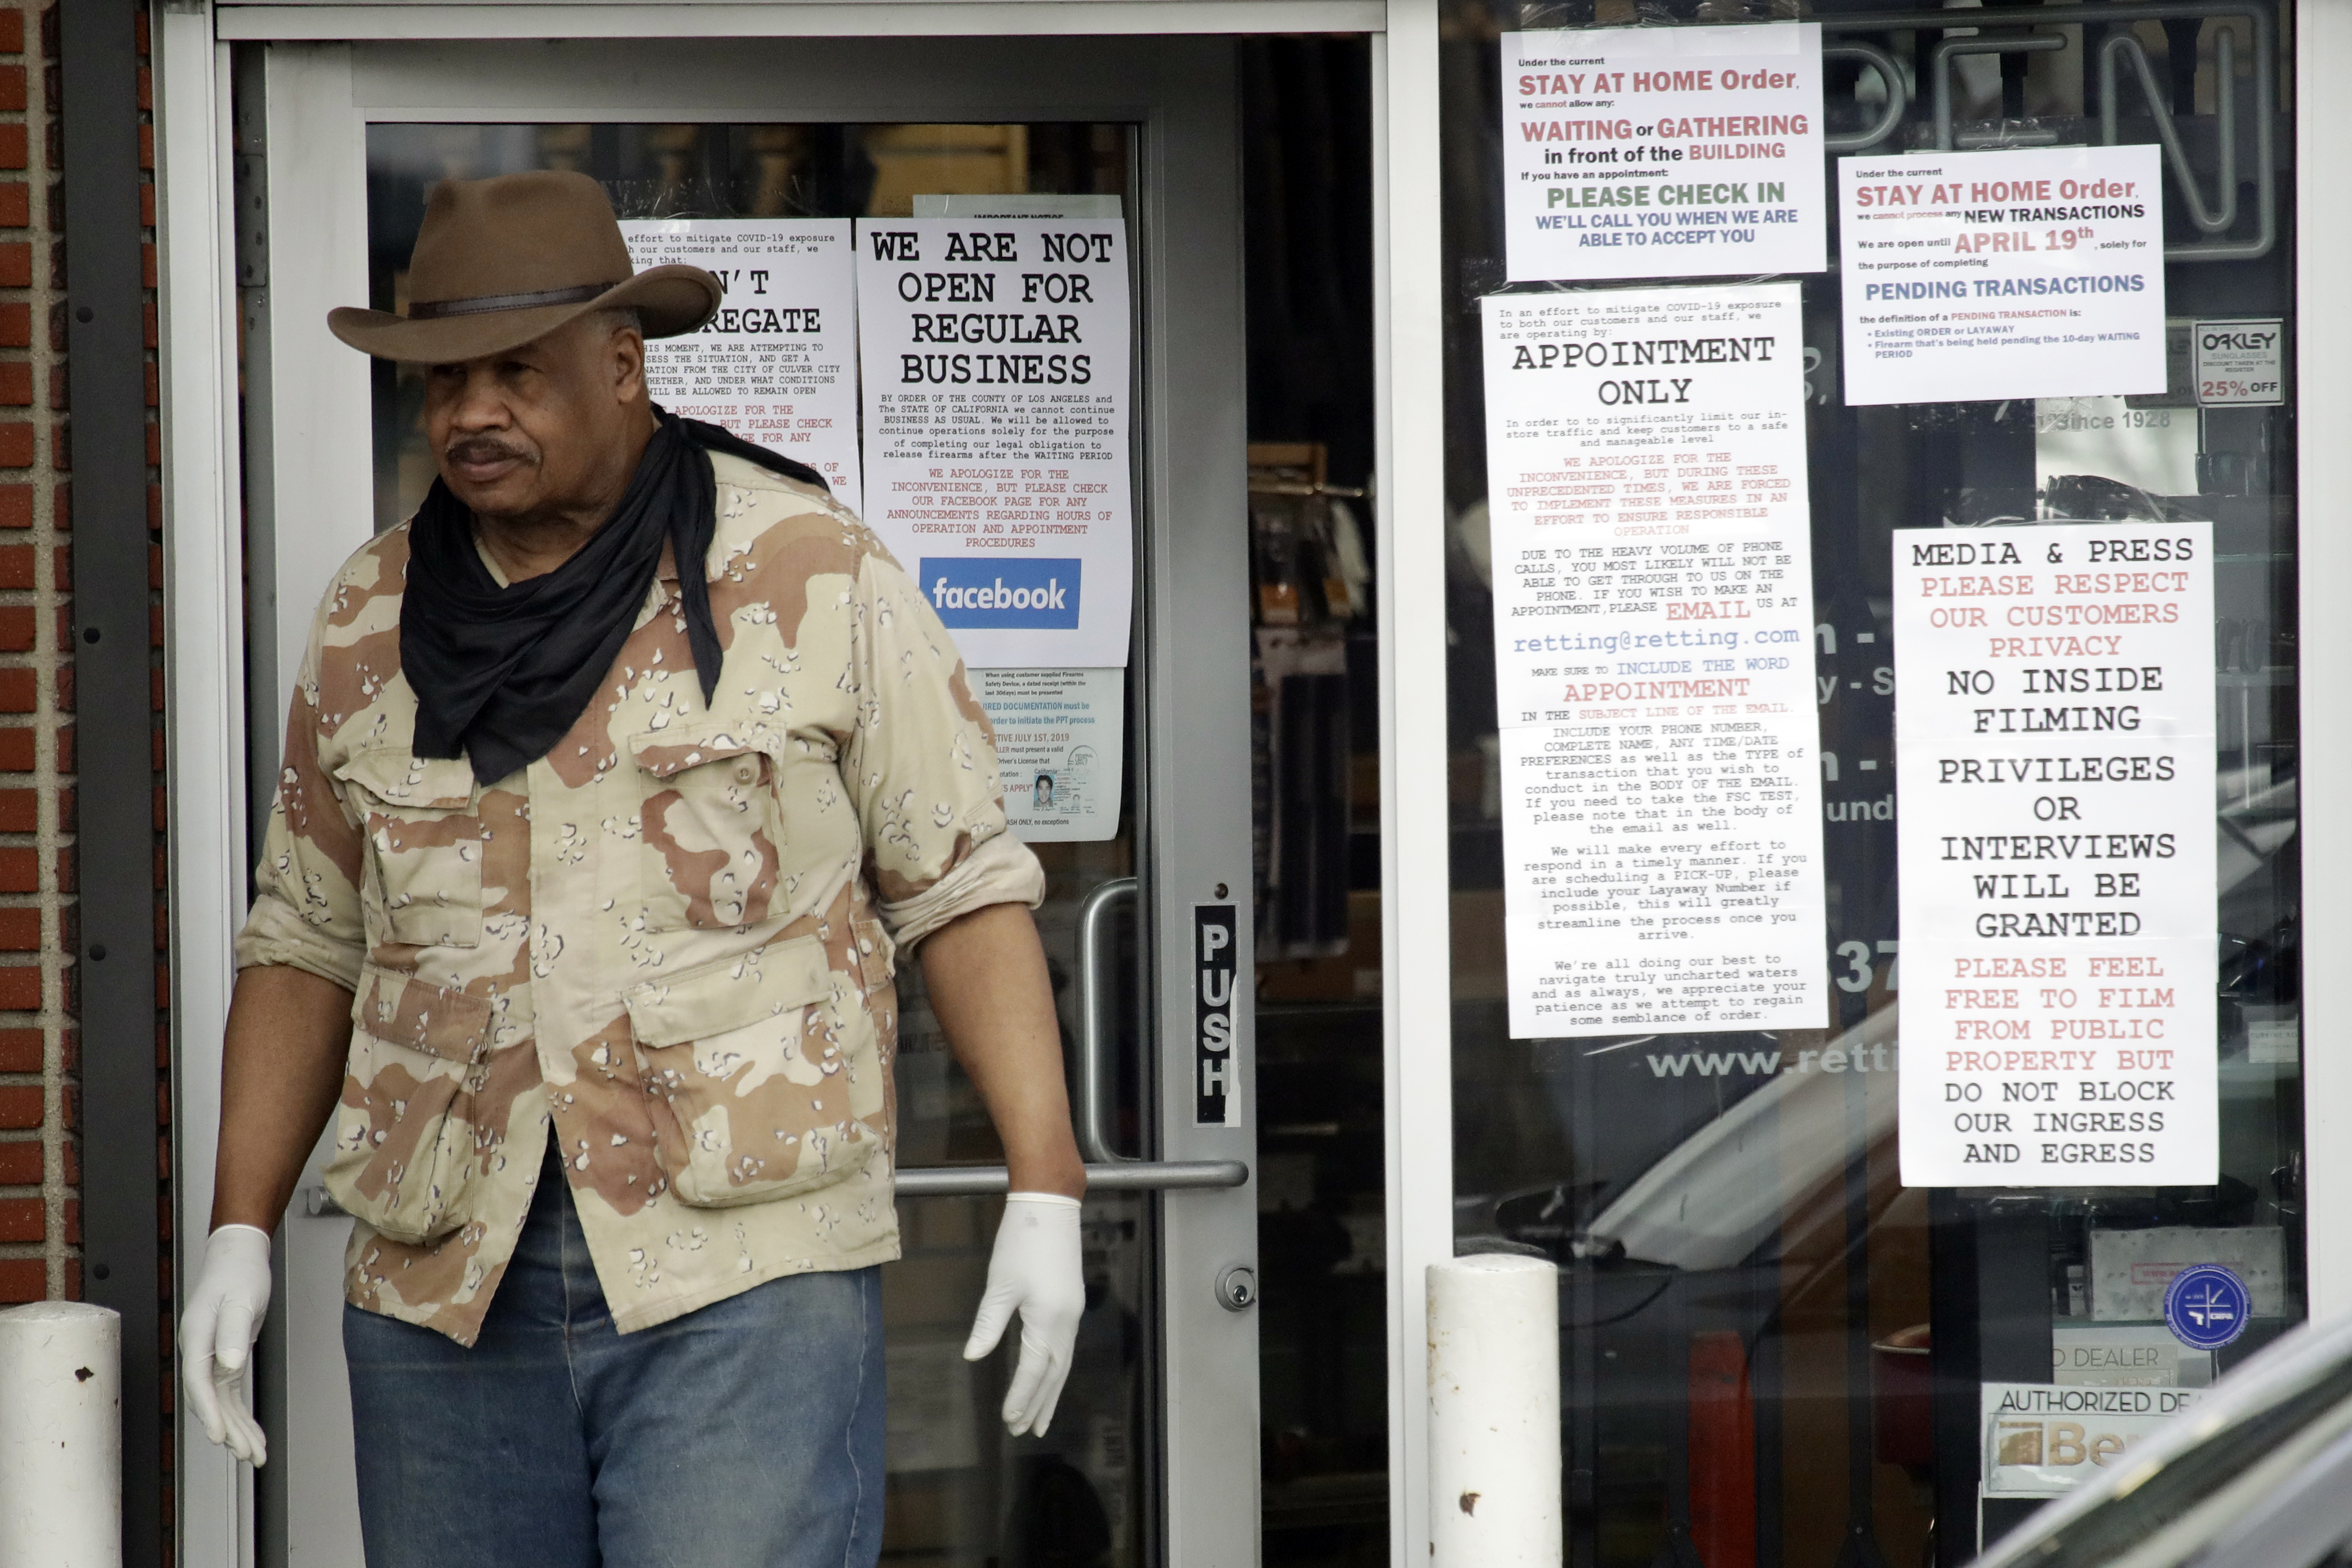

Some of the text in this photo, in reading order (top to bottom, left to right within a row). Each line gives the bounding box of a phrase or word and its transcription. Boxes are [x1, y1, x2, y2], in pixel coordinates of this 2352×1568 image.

[1569, 57, 1604, 65] current
[1519, 74, 1586, 95] STAY
[1593, 73, 1625, 93] AT
[1633, 70, 1712, 92] HOME
[1521, 114, 1808, 141] WAITING or GATHERING
[1545, 143, 1785, 164] in front of the BUILDING
[1521, 171, 1529, 180] If
[1532, 173, 1550, 181] you
[1906, 168, 1942, 176] current
[1547, 181, 1784, 208] PLEASE CHECK IN
[1856, 184, 1923, 207] STAY
[1931, 183, 1963, 204] AT
[1971, 180, 2051, 203] HOME
[1536, 209, 1798, 229] WE'LL CALL YOU WHEN WE ARE
[1964, 205, 2144, 223] NEW TRANSACTIONS
[628, 234, 663, 242] effort
[686, 234, 731, 243] mitigate
[737, 233, 783, 242] COVID-19
[789, 235, 835, 243] exposure
[870, 232, 1112, 263] WE ARE NOT
[1579, 229, 1754, 247] ABLE TO ACCEPT YOU
[1927, 238, 1950, 246] until
[1954, 231, 2036, 254] APRIL
[2045, 226, 2093, 250] 19th
[2100, 241, 2129, 250] solely
[898, 272, 1093, 303] OPEN FOR
[1866, 274, 2144, 300] PENDING TRANSACTIONS
[696, 308, 821, 334] REGATE
[911, 313, 1082, 344] REGULAR
[1874, 329, 1914, 337] Existing
[1916, 327, 1951, 336] ORDER
[1967, 325, 2014, 334] LAYAWAY
[2203, 332, 2277, 350] OAKLEY
[1512, 336, 1774, 370] APPOINTMENT
[900, 354, 1090, 384] BUSINESS
[931, 394, 943, 402] OF
[1598, 378, 1692, 406] ONLY
[2202, 380, 2278, 397] 25% OFF
[2122, 411, 2171, 429] 1928
[1580, 434, 1714, 447] and manageable level
[965, 538, 1035, 548] PROCEDURES
[1912, 538, 2193, 566] MEDIA & PRESS
[932, 577, 1066, 610] facebook
[1921, 571, 2188, 597] PLEASE RESPECT
[1666, 600, 1750, 620] EMAIL
[1930, 602, 2178, 628] OUR CUSTOMERS
[1514, 629, 1800, 652] retting@retting.com
[1989, 635, 2122, 658] PRIVACY
[1563, 678, 1750, 702] APPOINTMENT
[1947, 667, 2162, 695] NO INSIDE
[1973, 705, 2141, 733] FILMING
[1014, 733, 1031, 742] JULY
[1050, 733, 1069, 741] 2019
[1938, 756, 2175, 783] PRIVILEGES
[2034, 796, 2081, 821] OR
[1941, 833, 2175, 860] INTERVIEWS
[1973, 873, 2140, 899] WILL BE
[1976, 912, 2141, 938] GRANTED
[1829, 940, 1898, 993] 37
[1955, 957, 2164, 978] PLEASE FEEL
[1202, 924, 1230, 1096] PUSH
[1945, 988, 2175, 1009] FREE TO FILM
[1570, 1016, 1603, 1025] some
[1612, 1013, 1686, 1023] semblance
[1694, 1011, 1711, 1020] of
[1955, 1019, 2164, 1040] FROM PUBLIC
[1946, 1050, 2173, 1071] PROPERTY BUT
[1945, 1081, 2175, 1102] DO NOT BLOCK
[1954, 1112, 2164, 1132] OUR INGRESS
[1963, 1144, 2154, 1163] AND EGRESS
[2074, 1347, 2159, 1367] DEALER
[2000, 1390, 2203, 1413] AUTHORIZED DE
[2048, 1421, 2140, 1467] Be
